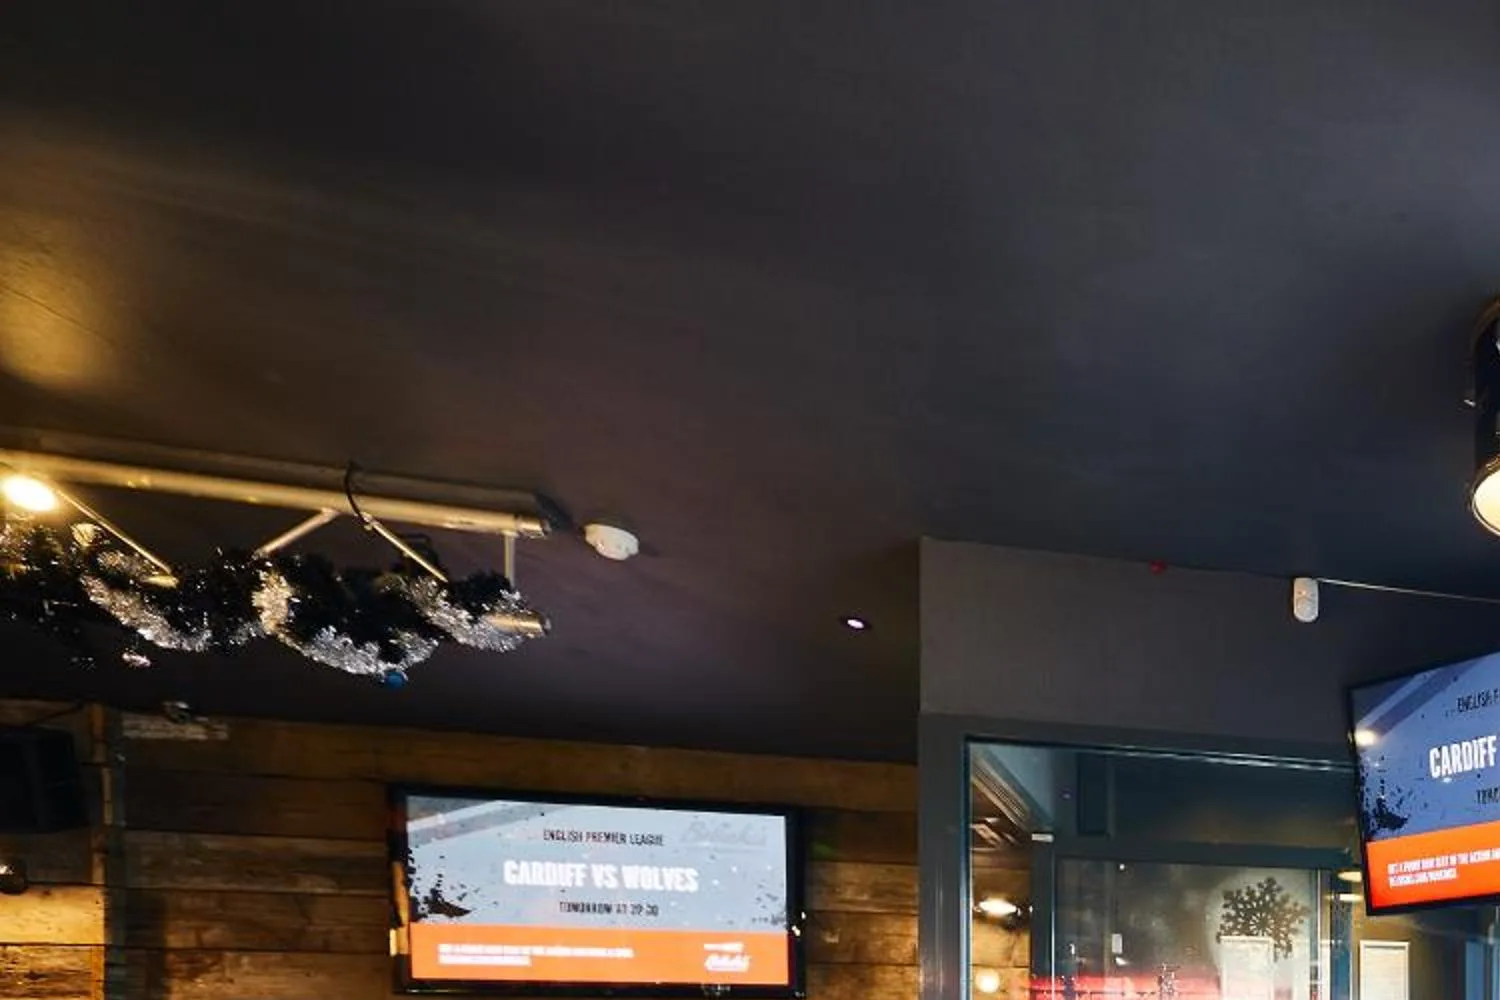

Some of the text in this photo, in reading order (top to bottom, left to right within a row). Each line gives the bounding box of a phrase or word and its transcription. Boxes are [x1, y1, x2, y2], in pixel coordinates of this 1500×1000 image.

[1429, 734, 1498, 780] CARDIFF
[543, 828, 665, 847] ENGLISH PREMIER LEAGUE
[503, 860, 700, 894] CARDIFF VS WOLVES
